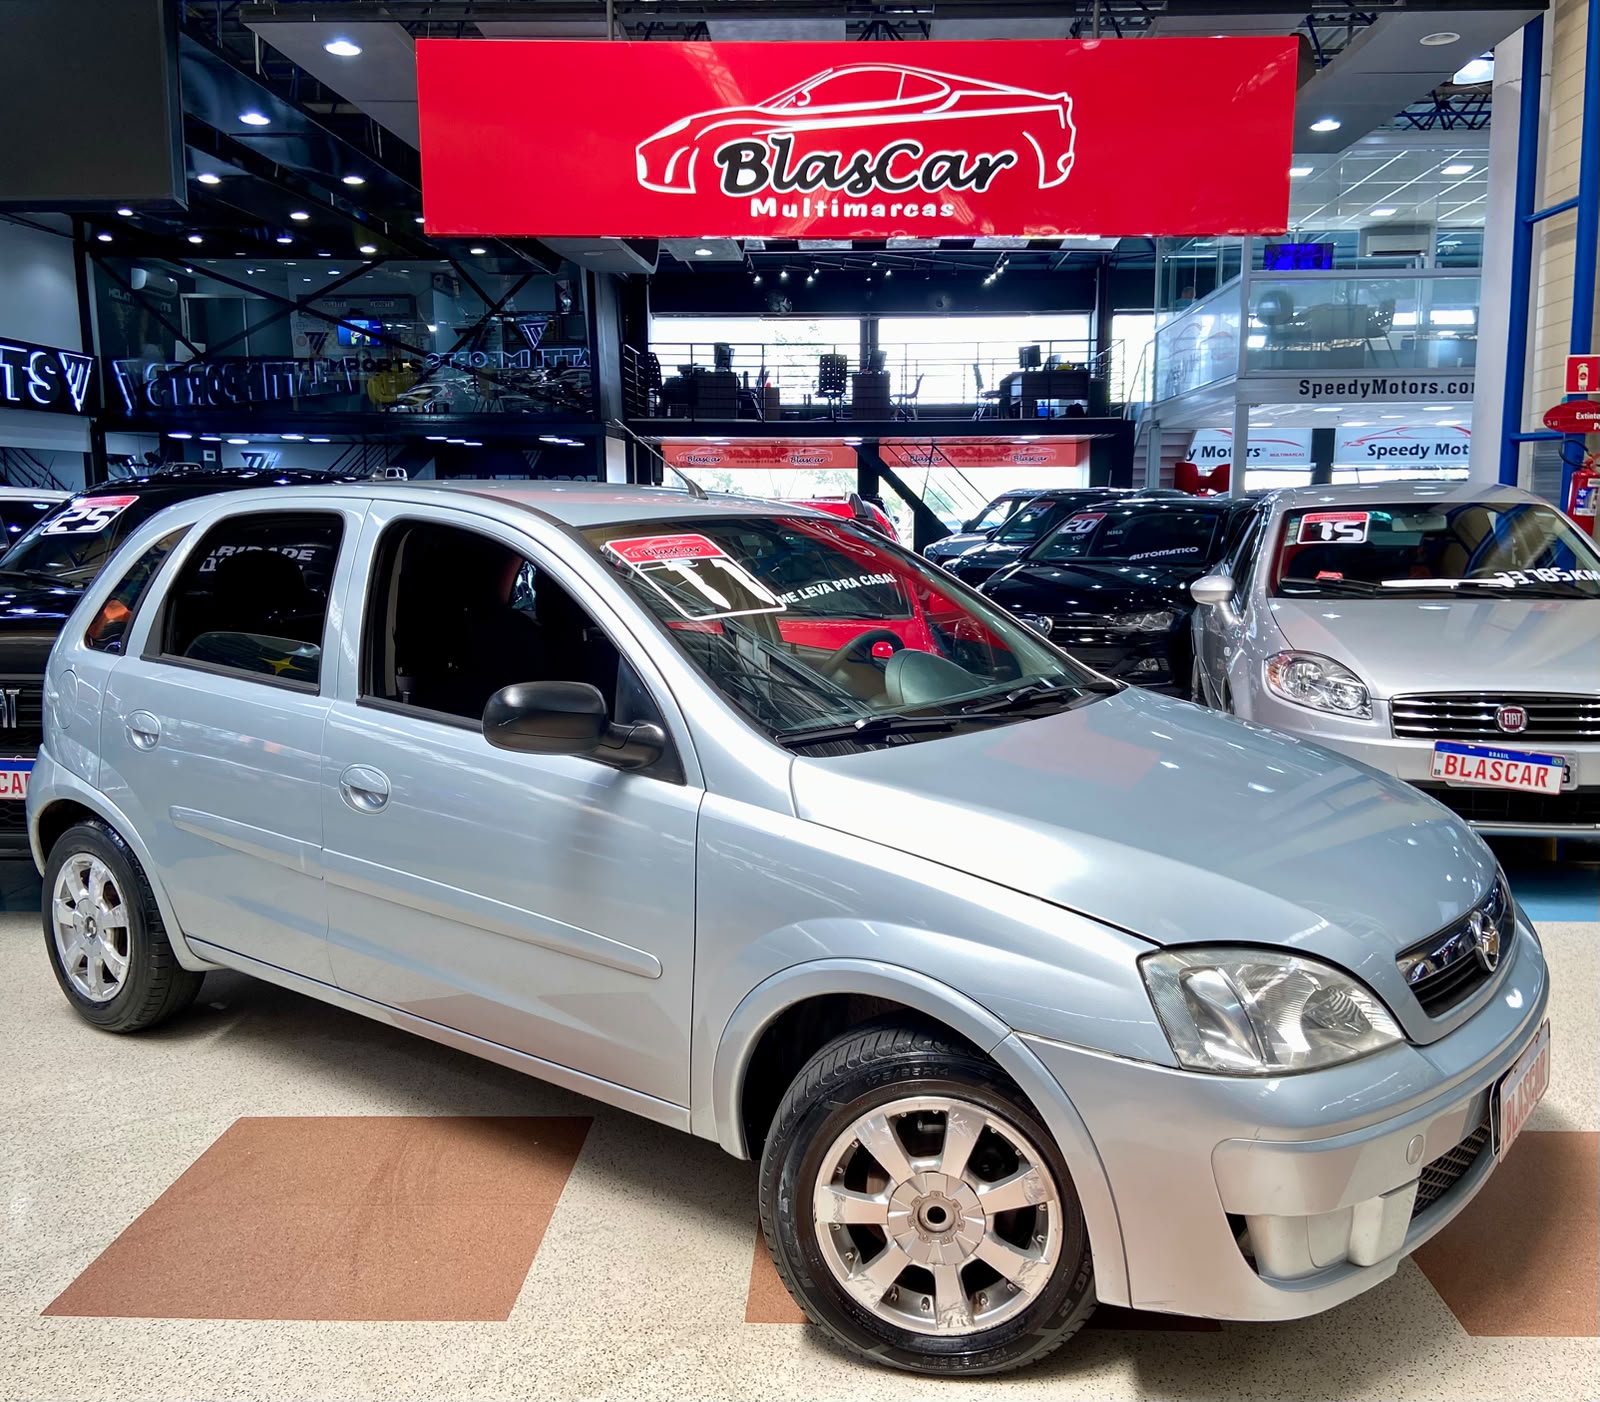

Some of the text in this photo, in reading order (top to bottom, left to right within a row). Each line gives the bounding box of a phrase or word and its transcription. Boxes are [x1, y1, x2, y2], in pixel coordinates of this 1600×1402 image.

[715, 132, 1018, 196] BlasCar
[750, 197, 956, 219] Multimarcas
[1201, 445, 1261, 459] Motrs
[1367, 443, 1430, 460] Speedy
[47, 507, 110, 532] 25
[1061, 518, 1096, 533] 20
[1319, 521, 1364, 542] 15
[778, 572, 898, 604] ME LEVA PRA CASA!
[1504, 712, 1522, 726] FIAT
[1488, 751, 1510, 760] BRASIL
[1444, 754, 1549, 788] BLASCAR
